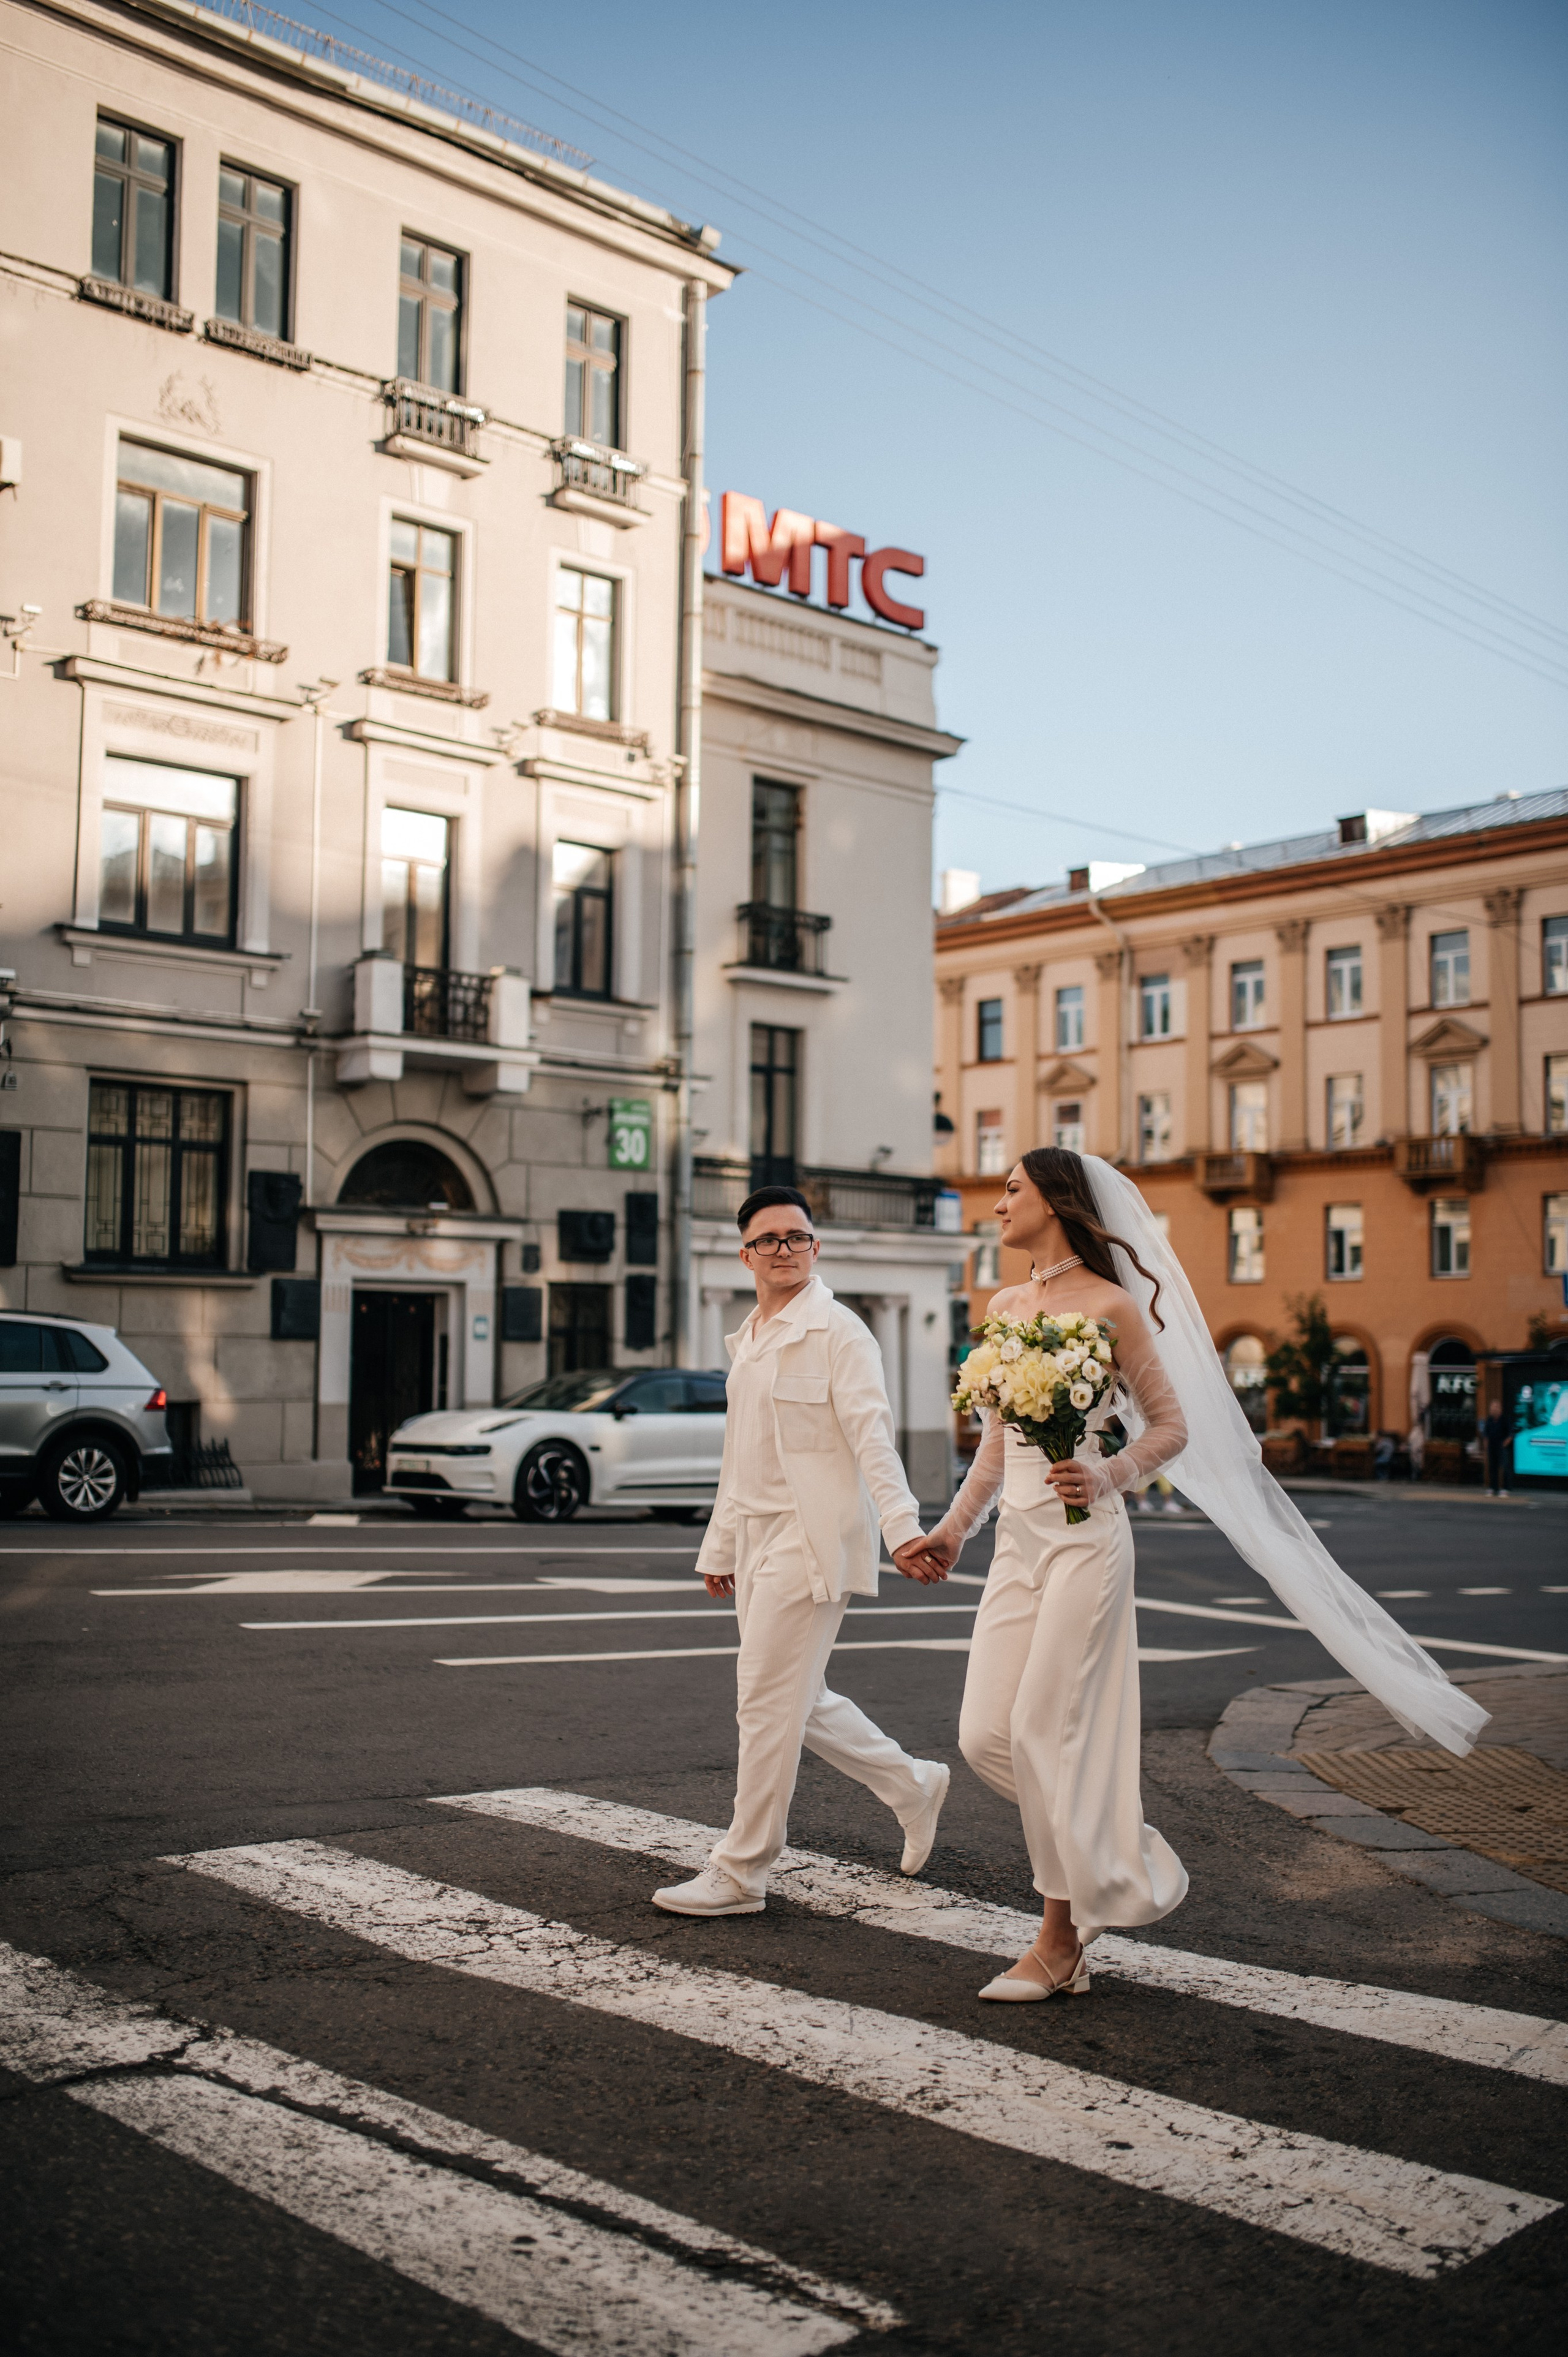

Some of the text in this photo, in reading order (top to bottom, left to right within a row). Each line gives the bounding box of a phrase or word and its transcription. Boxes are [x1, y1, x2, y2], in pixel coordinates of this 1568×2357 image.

[722, 491, 924, 630] МТС
[616, 1128, 646, 1163] 30
[1437, 1374, 1477, 1393] KFC
